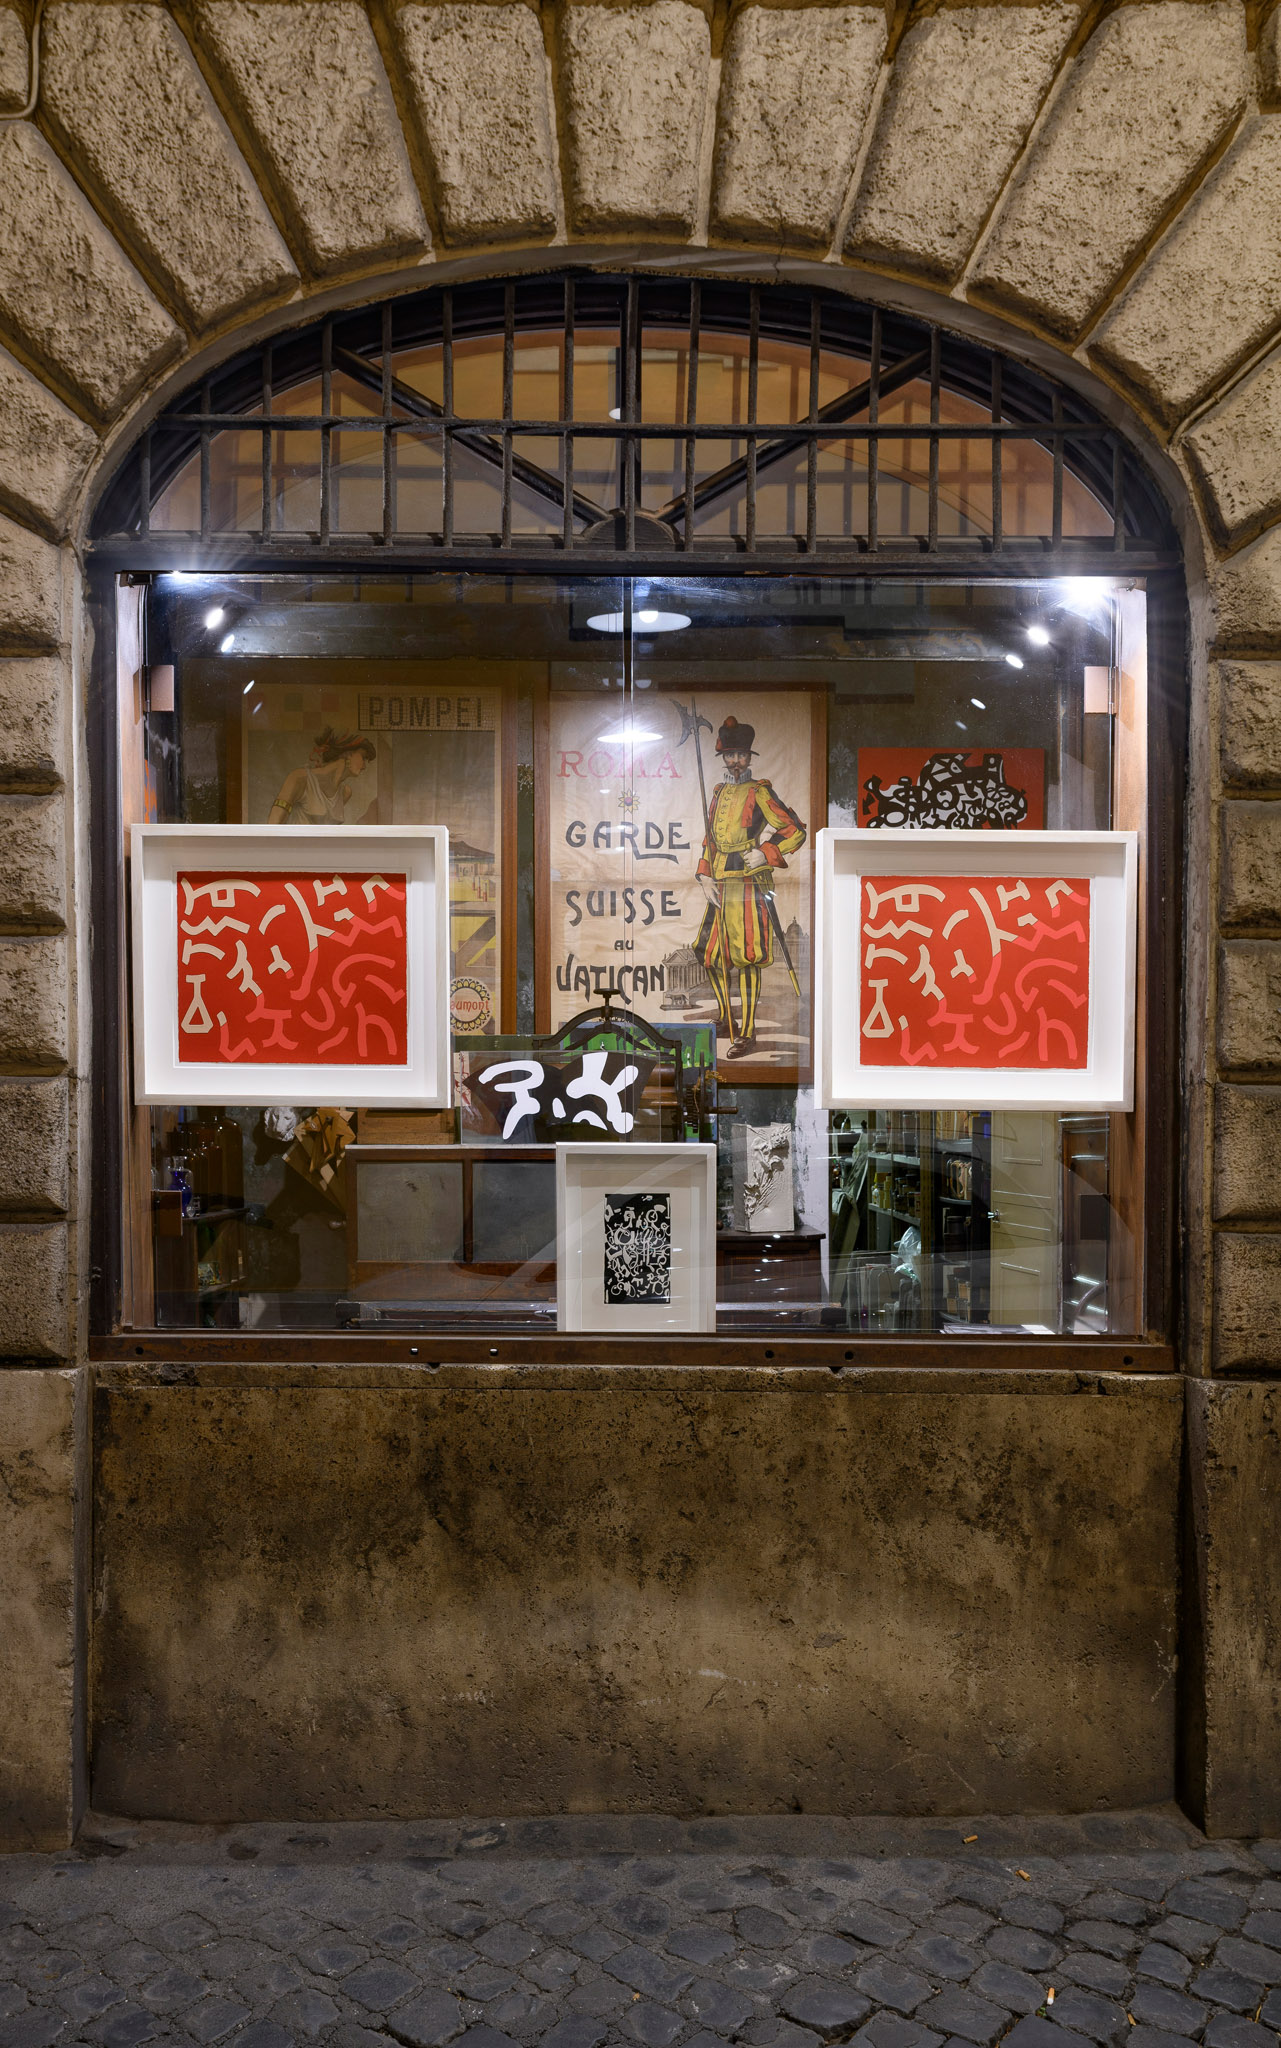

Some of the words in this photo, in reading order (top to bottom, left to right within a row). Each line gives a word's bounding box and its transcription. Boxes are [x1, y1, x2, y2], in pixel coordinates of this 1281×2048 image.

[369, 696, 482, 727] POMPEI
[556, 750, 682, 778] ROMA
[565, 820, 690, 864] GARDE
[566, 887, 682, 926] SUISSE
[614, 939, 634, 950] AU
[556, 953, 665, 1004] VATICAN
[450, 1000, 489, 1012] aumont
